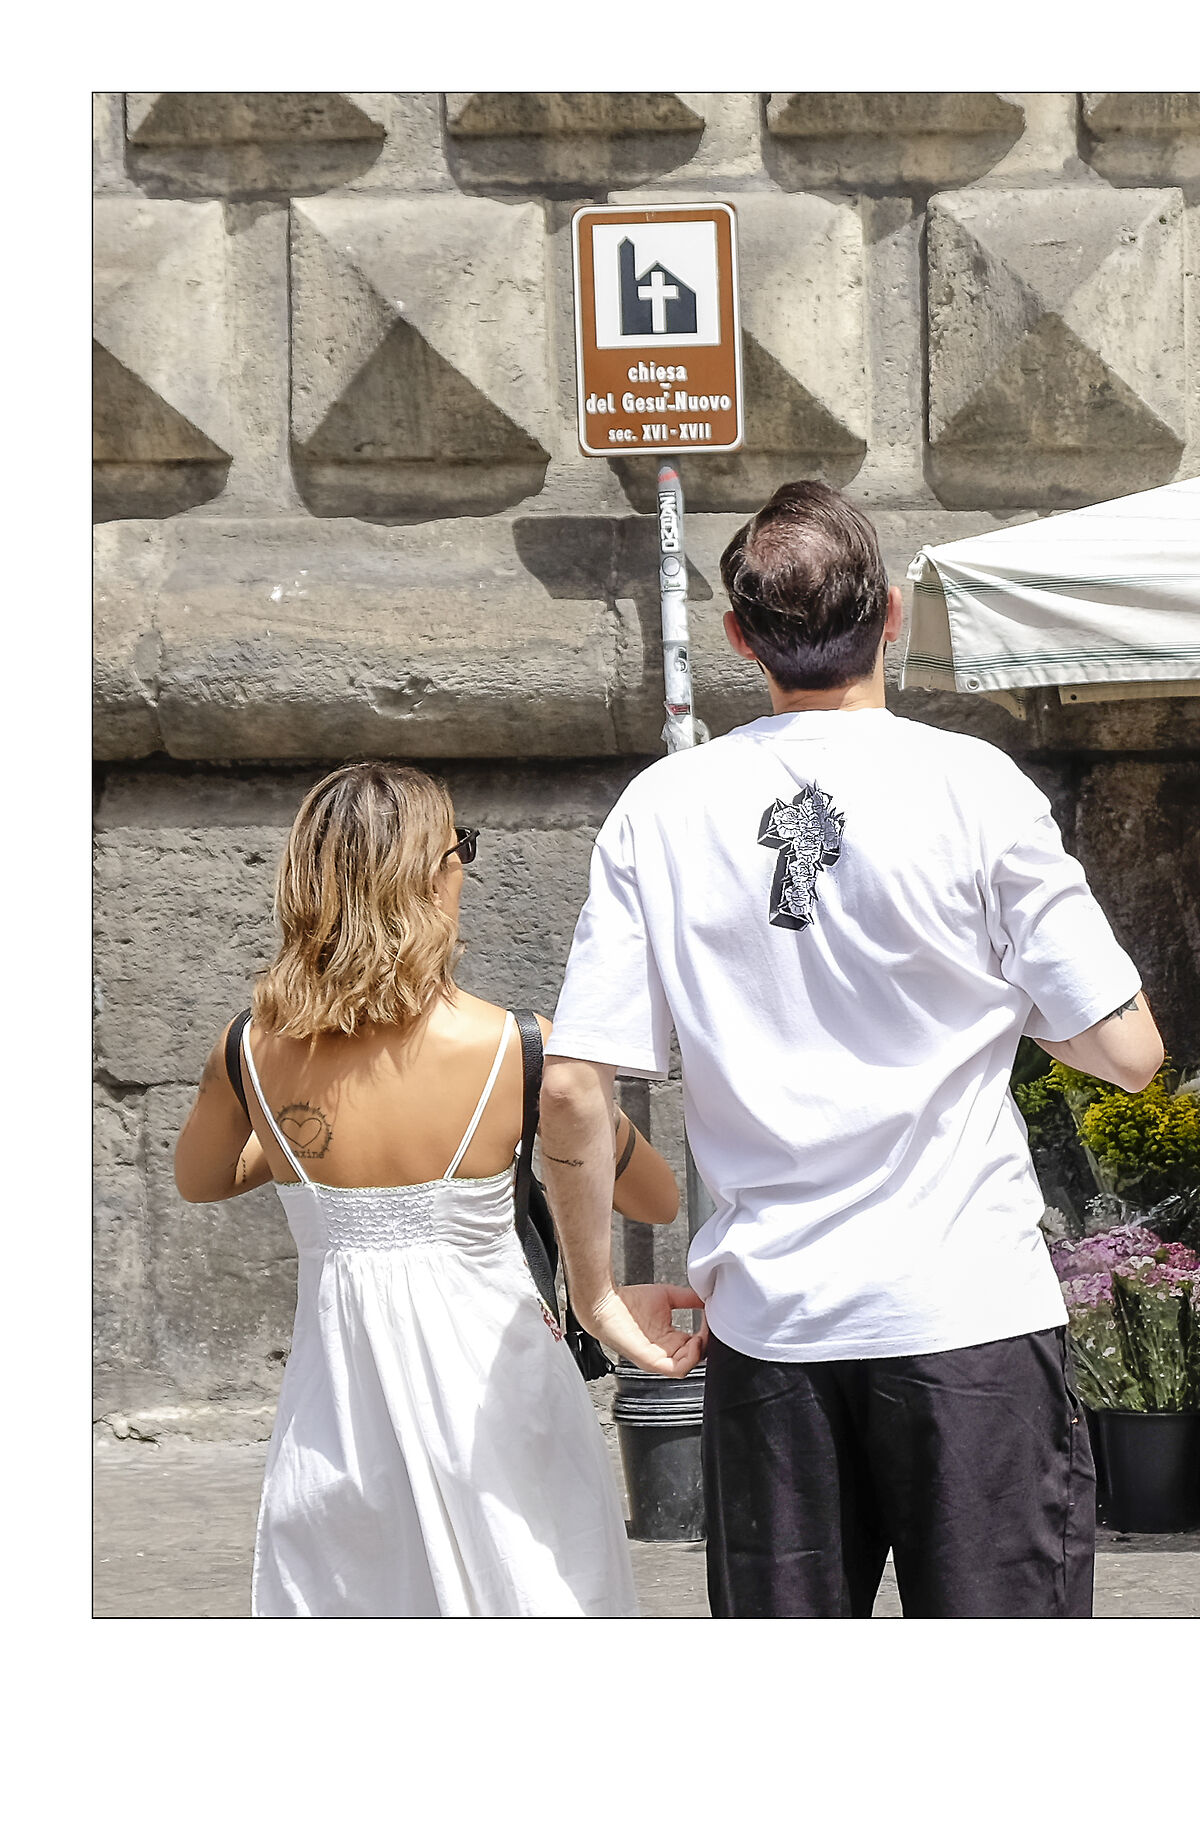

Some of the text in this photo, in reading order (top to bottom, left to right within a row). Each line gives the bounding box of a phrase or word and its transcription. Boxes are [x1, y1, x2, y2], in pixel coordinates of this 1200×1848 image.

[627, 361, 688, 382] chiesa
[586, 392, 616, 414] del
[674, 391, 732, 412] Nuovo
[608, 428, 638, 441] sec.
[293, 1149, 325, 1159] axine
